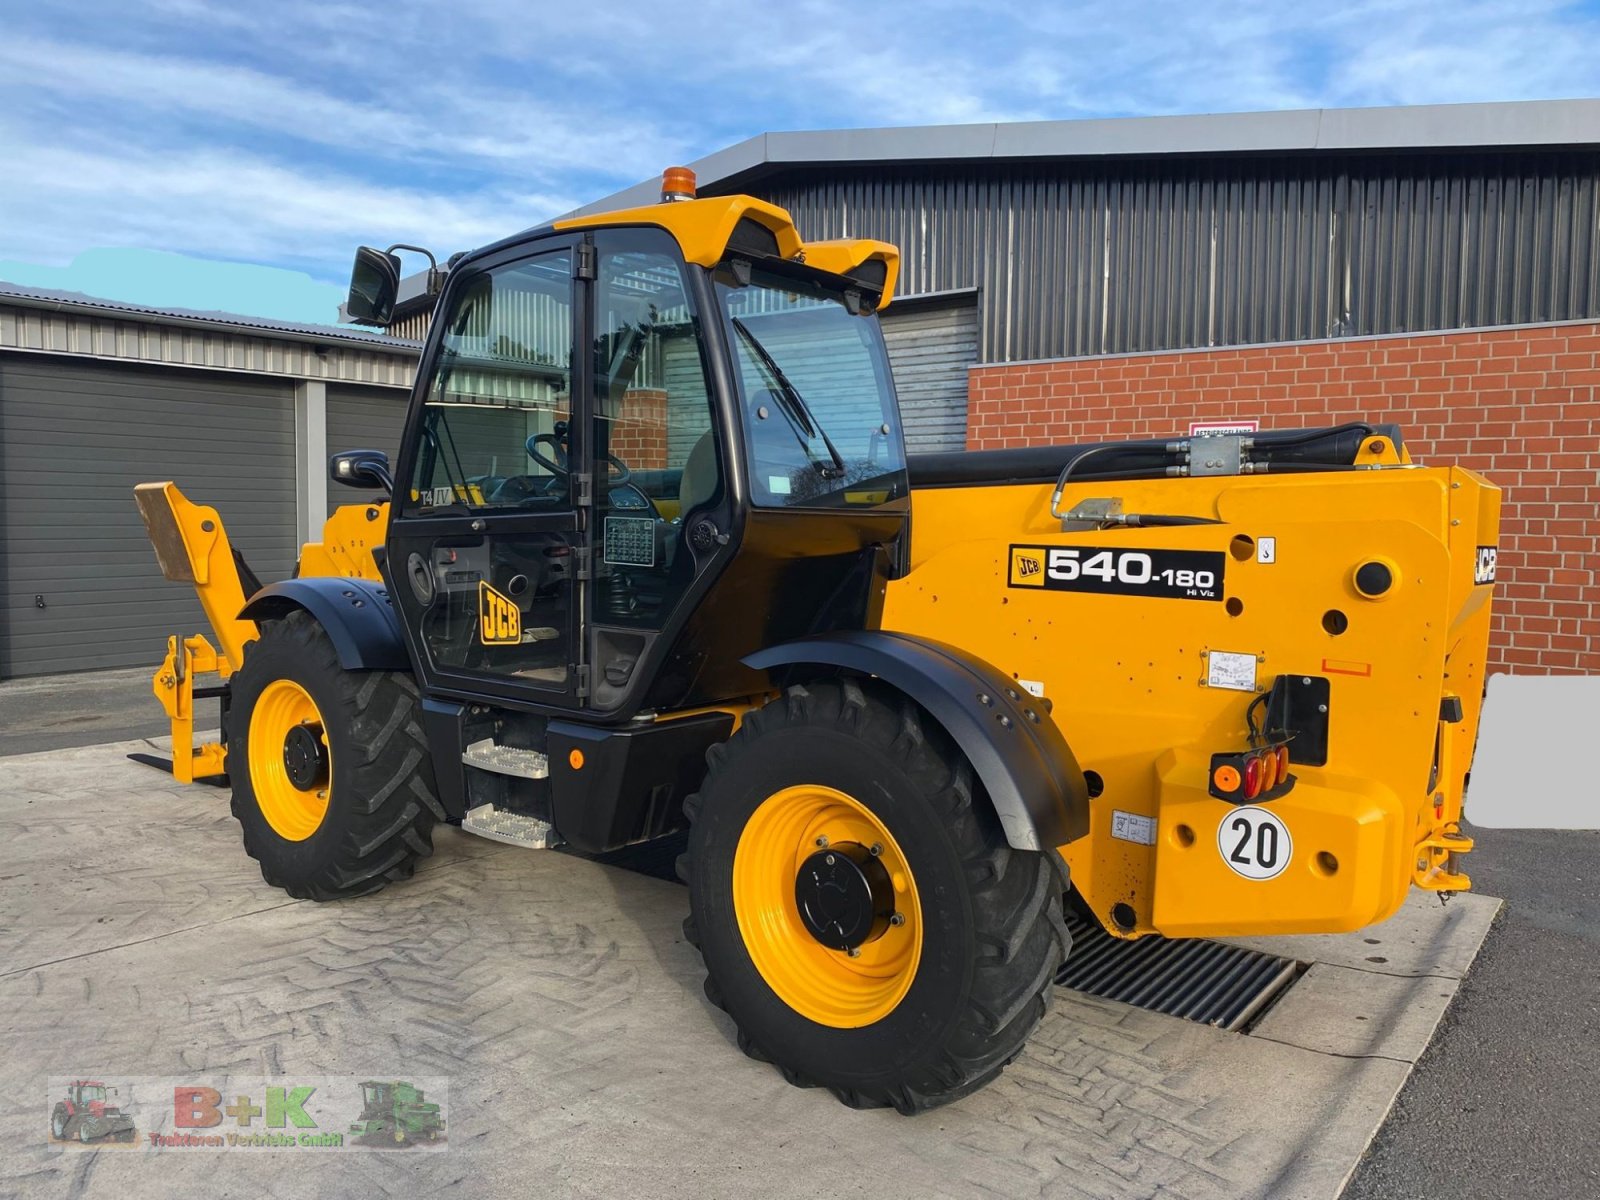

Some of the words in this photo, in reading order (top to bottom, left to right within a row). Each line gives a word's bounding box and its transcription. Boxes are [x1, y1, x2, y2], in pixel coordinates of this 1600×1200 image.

[1019, 556, 1039, 576] JCB
[1047, 549, 1215, 588] 540-180
[1200, 589, 1215, 597] Viz
[483, 590, 519, 640] JCB
[1230, 817, 1278, 869] 20
